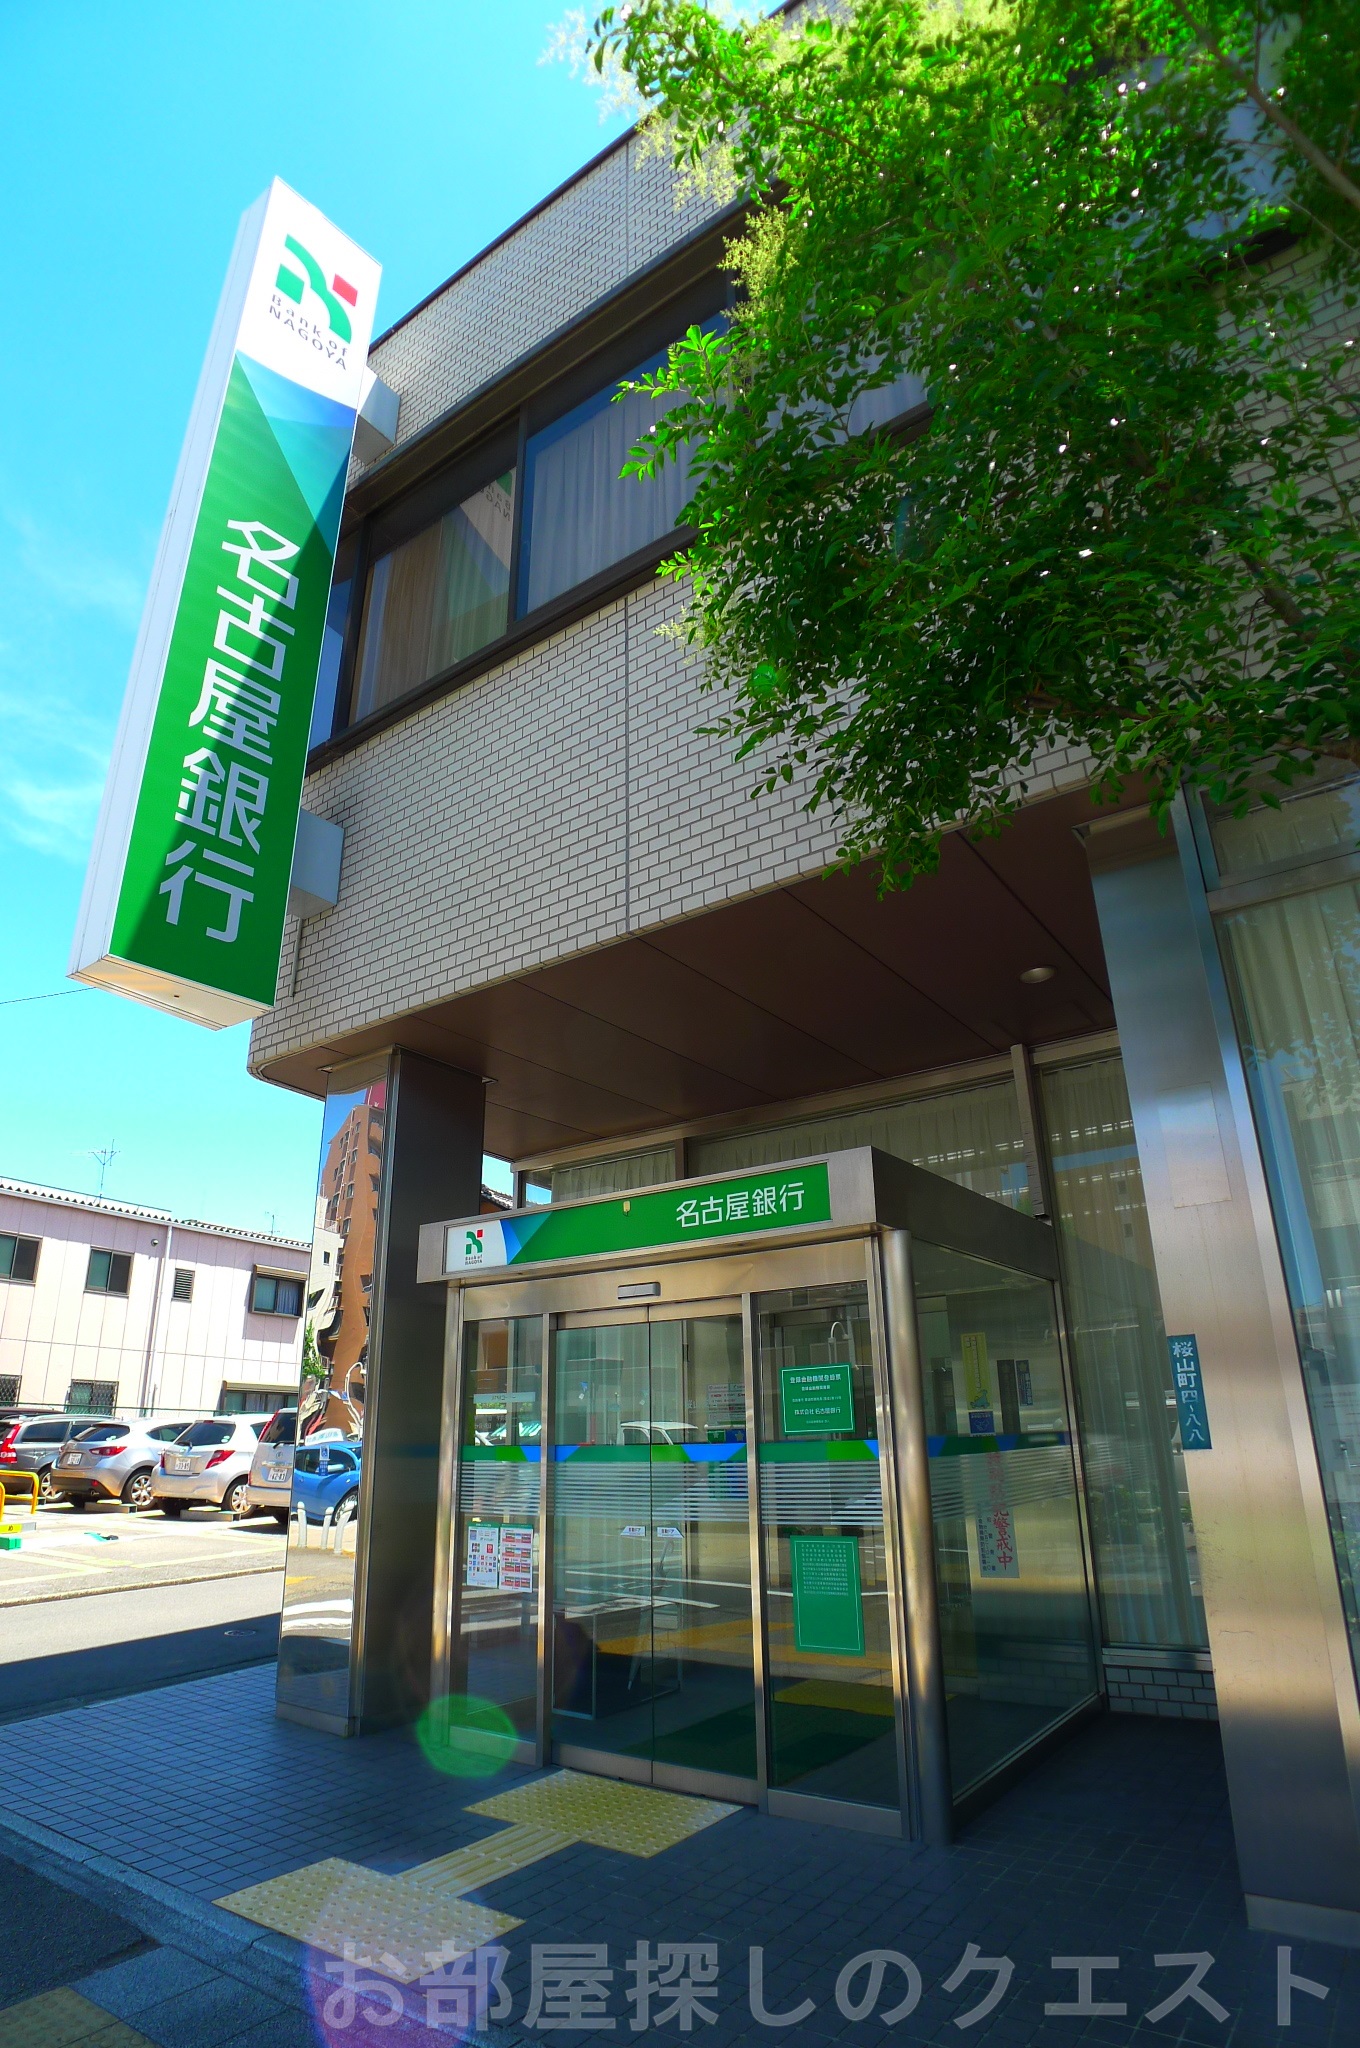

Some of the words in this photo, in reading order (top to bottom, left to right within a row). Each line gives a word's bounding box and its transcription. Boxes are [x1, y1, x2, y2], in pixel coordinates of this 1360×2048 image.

[269, 305, 347, 371] NAGOYA
[271, 294, 321, 338] Bank
[329, 340, 348, 357] of
[158, 519, 301, 944] 名古屋銀行
[675, 1181, 805, 1229] 名古屋銀行
